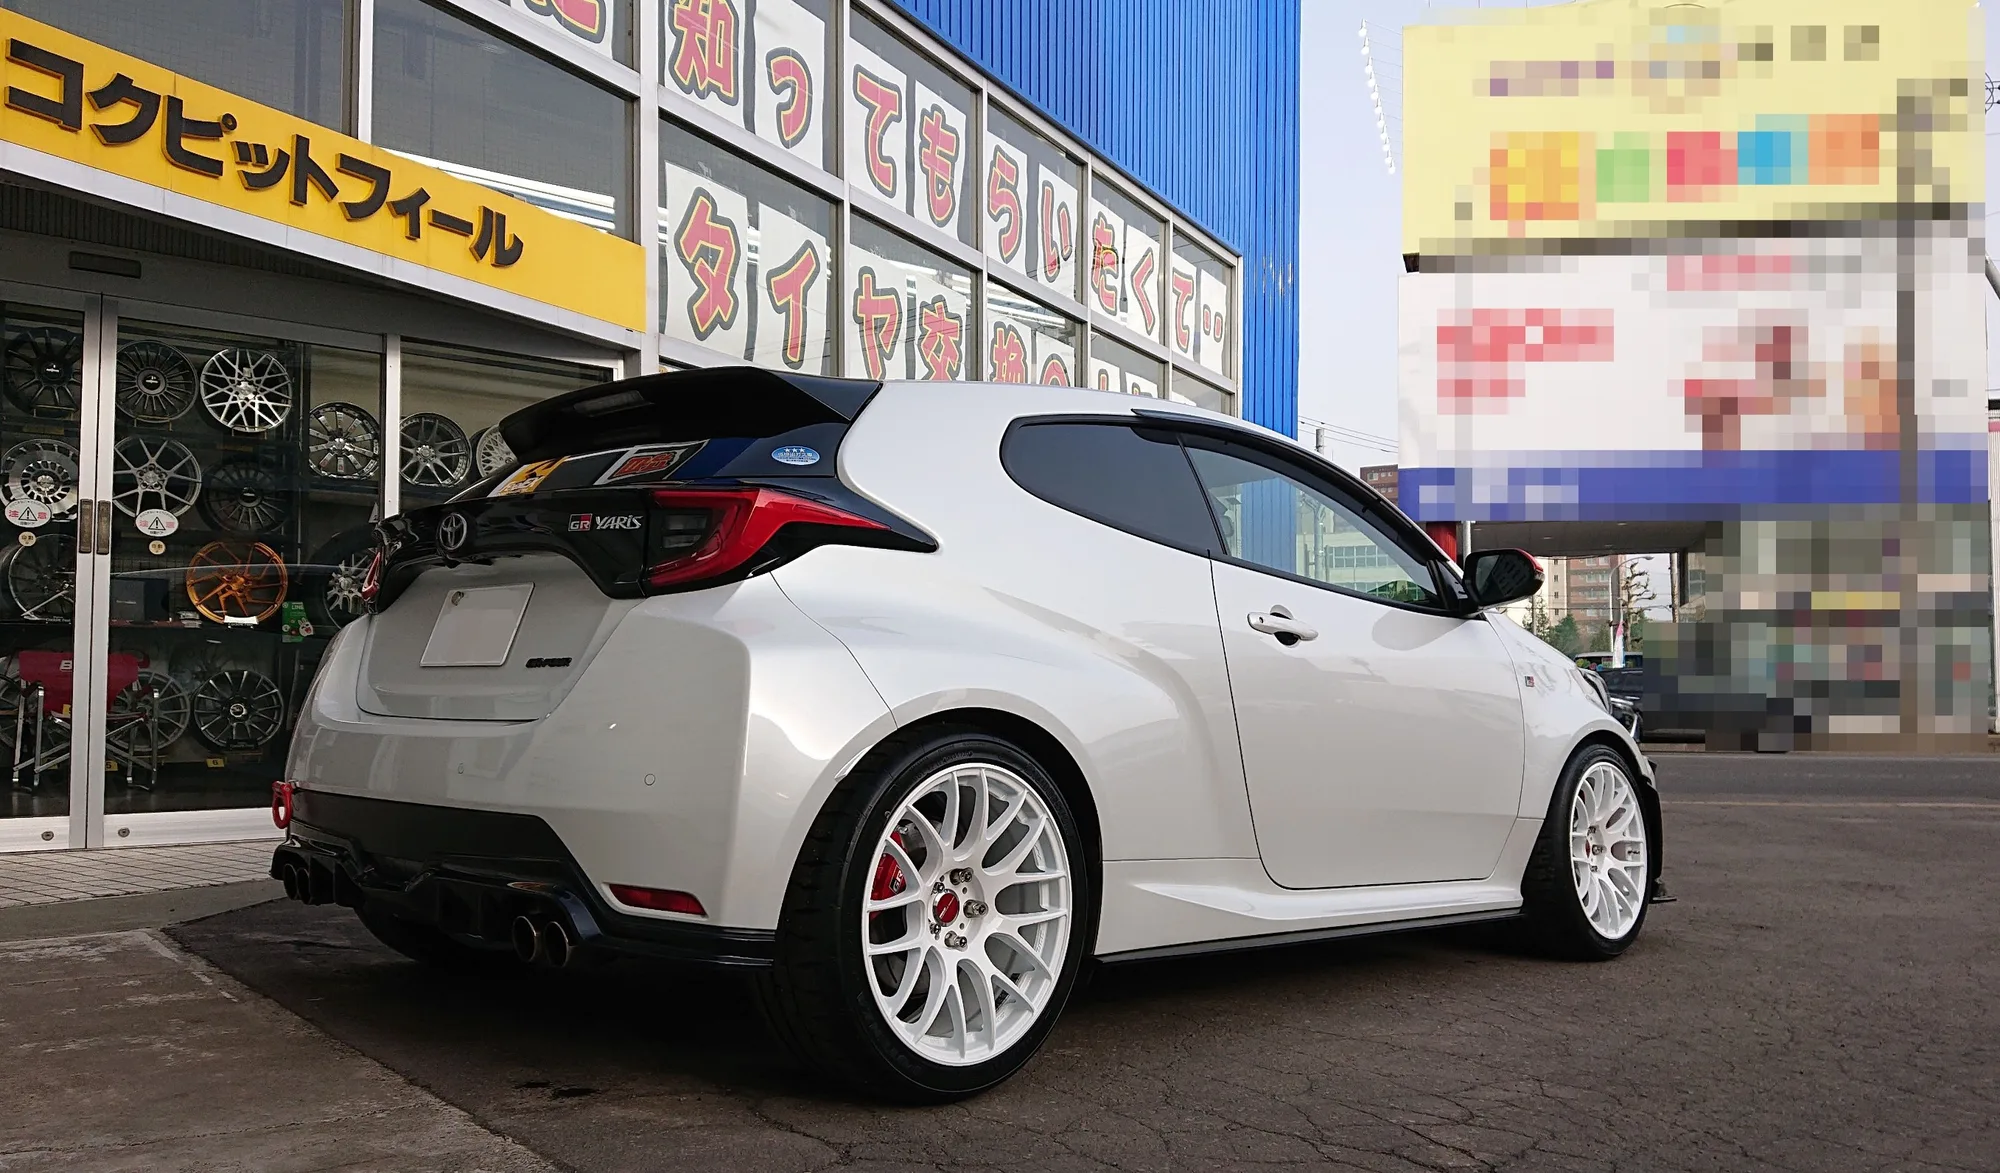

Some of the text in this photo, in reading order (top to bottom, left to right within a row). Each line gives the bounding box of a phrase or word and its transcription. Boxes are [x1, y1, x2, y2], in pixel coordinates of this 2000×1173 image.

[4, 38, 524, 267] コクピットフィール
